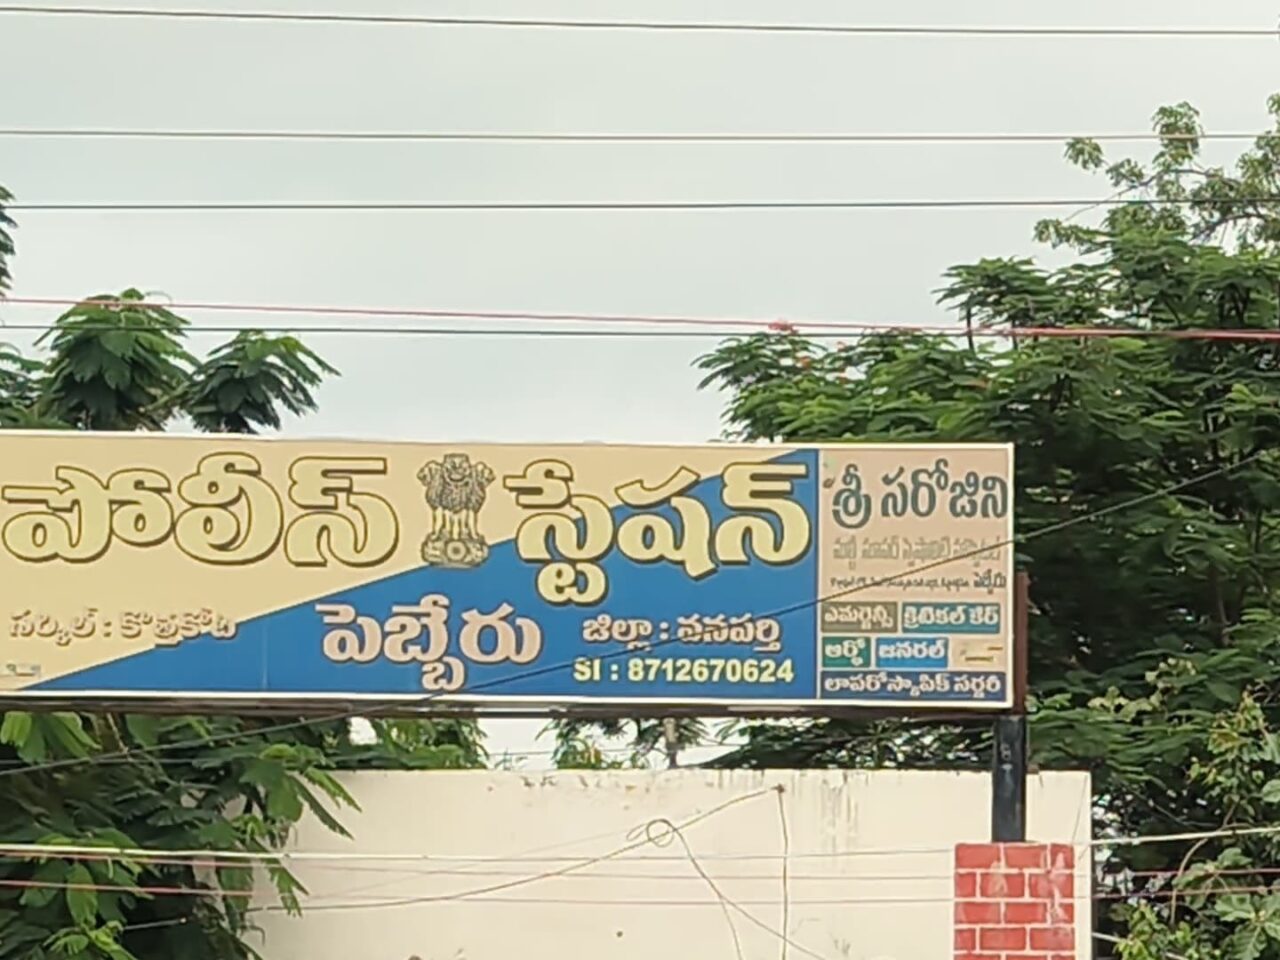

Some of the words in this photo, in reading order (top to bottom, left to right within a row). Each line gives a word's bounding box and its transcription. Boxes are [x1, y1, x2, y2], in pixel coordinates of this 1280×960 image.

[2, 451, 400, 567] పోలీస్
[503, 459, 811, 606] స్టేషన్
[832, 463, 872, 529] శ్రీ
[881, 458, 1008, 519] సరోజిని
[315, 593, 542, 692] పెబ్బేరు
[582, 614, 654, 652] జిల్లా
[676, 613, 781, 652] వనపర్తి
[573, 657, 600, 681] SI
[627, 658, 794, 683] 8712670624
